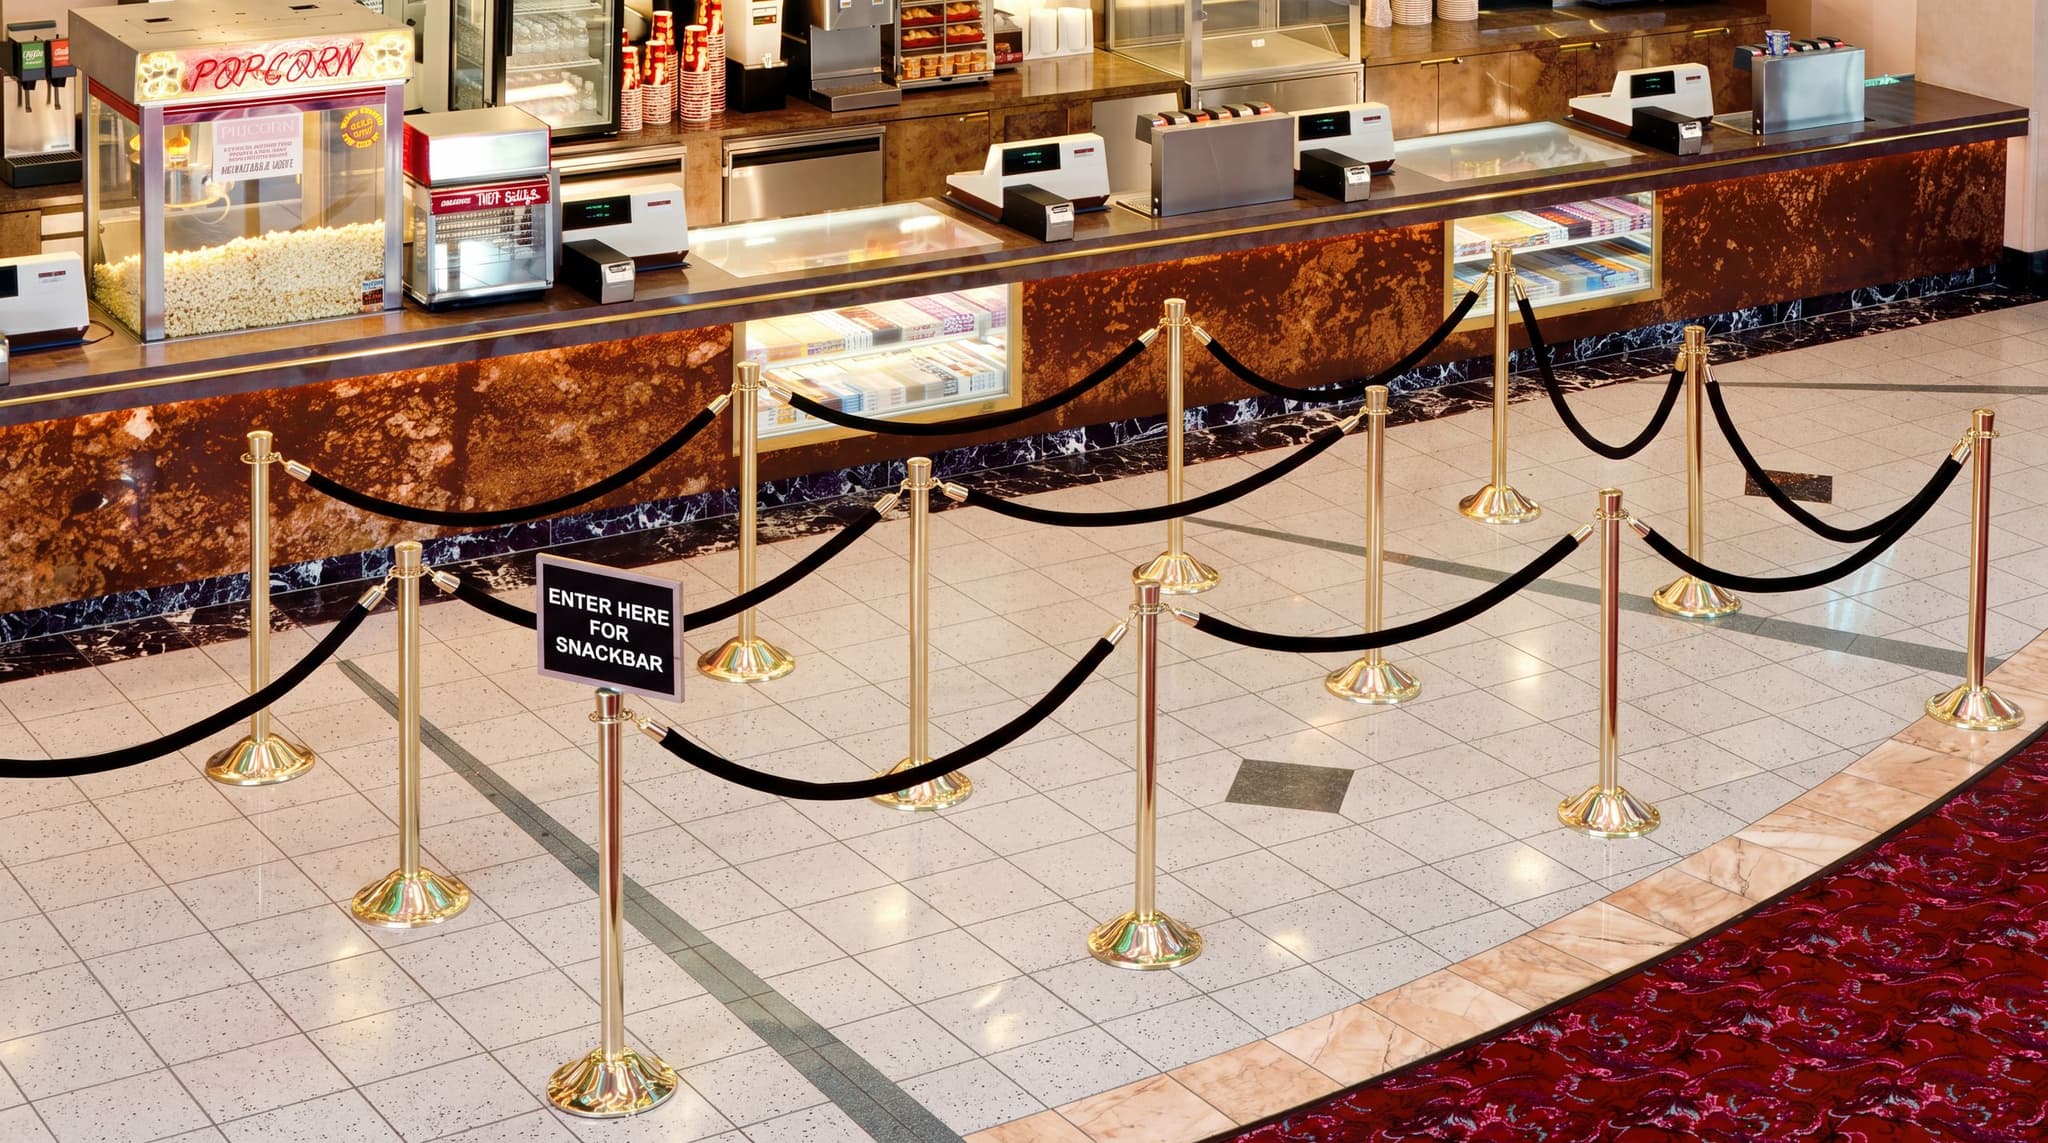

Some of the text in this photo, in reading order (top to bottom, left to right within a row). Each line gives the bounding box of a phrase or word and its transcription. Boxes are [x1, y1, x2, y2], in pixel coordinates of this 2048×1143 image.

[189, 41, 365, 92] POPCORN
[548, 587, 671, 627] ENTER HERE
[589, 619, 630, 643] FOR
[555, 636, 664, 673] SNACKBAR
